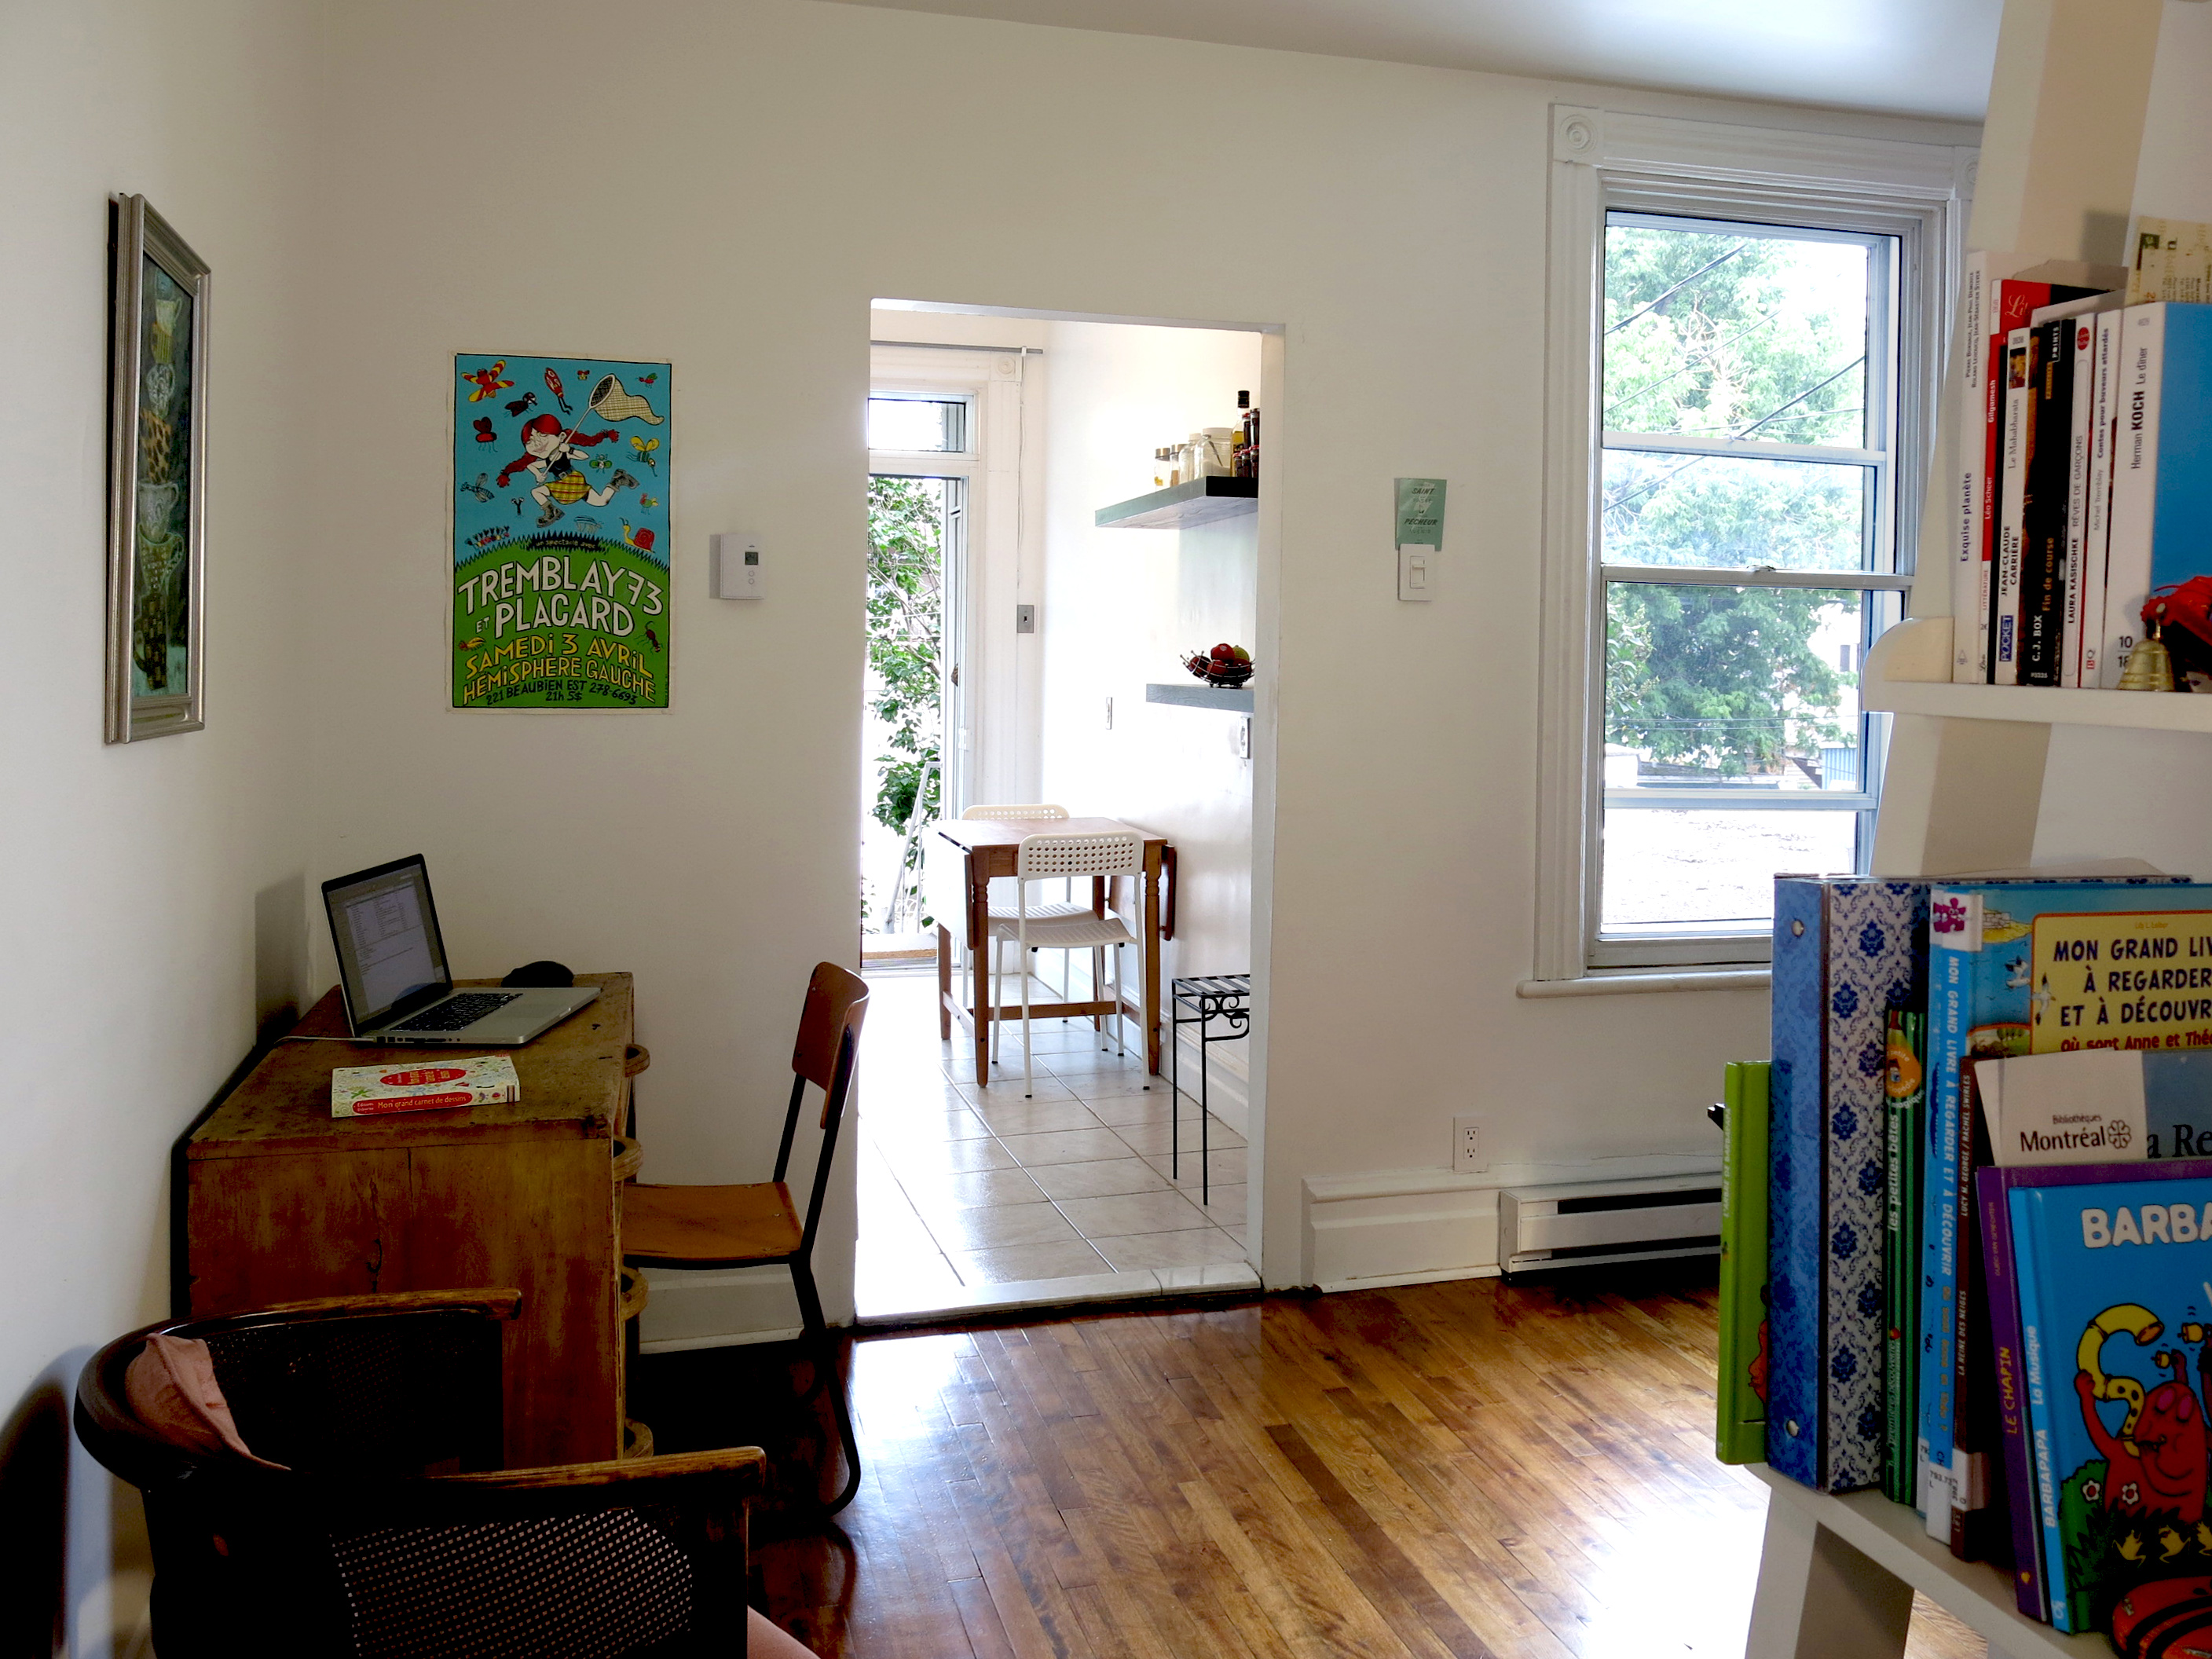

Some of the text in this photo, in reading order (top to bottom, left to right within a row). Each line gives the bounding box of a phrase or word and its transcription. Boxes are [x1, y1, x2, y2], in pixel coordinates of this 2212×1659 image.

[2136, 373, 2146, 385] Le
[2098, 405, 2107, 427] pour
[2131, 390, 2145, 431] KOCH
[2008, 398, 2020, 470] Le Mahabharata
[2074, 435, 2084, 481] GARÇONS
[2130, 433, 2143, 470] Herman
[2073, 483, 2081, 494] DE
[2095, 469, 2104, 504] Tremblay
[1960, 471, 1972, 562] Exquise planète
[2001, 525, 2011, 597] JEAN-CLAUDE
[2042, 537, 2055, 612] Fin de course
[2067, 538, 2078, 624] LAURA KASISCHKE
[475, 593, 635, 639] ET PLACARD
[2033, 614, 2042, 637] BOX
[562, 633, 579, 655] 3
[2000, 615, 2013, 661] POCKET
[2119, 635, 2133, 649] 10
[485, 690, 504, 705] 221
[566, 679, 588, 691] EST
[589, 681, 639, 705] 278-6693
[545, 690, 583, 702] 21h 5$
[585, 659, 657, 704] GAUCHE
[2053, 939, 2099, 962] MON
[2111, 937, 2178, 961] GRAND
[1948, 955, 1959, 985] MON
[2083, 965, 2212, 994] À REGARDER
[1946, 990, 1958, 1034] GRAND
[2060, 995, 2212, 1027] ET À DÉCOUVR
[1946, 1039, 1957, 1074] LIVRE
[2060, 1036, 2080, 1052] Où
[2086, 1037, 2119, 1051] sont
[2124, 1033, 2160, 1050] Anne
[2166, 1033, 2181, 1047] et
[1946, 1080, 1959, 1089] À
[394, 1100, 413, 1109] grand
[2052, 1114, 2102, 1125] Bibliothèques
[1943, 1094, 1956, 1163] REGARDER
[1961, 1111, 1970, 1142] RACHEL
[2020, 1126, 2106, 1152] Montréal
[1723, 1165, 1730, 1177] DE
[1887, 1114, 1902, 1232] les petites bêtes
[1943, 1166, 1954, 1184] ET
[1961, 1150, 1970, 1182] GEORGE
[1943, 1188, 1957, 1198] À
[1961, 1196, 1969, 1218] LUCY
[1941, 1203, 1957, 1276] DÉCOUVRIR
[1958, 1290, 1967, 1319] NEIGES
[1957, 1339, 1966, 1364] REINE
[1958, 1365, 1965, 1376] LA
[1999, 1346, 2018, 1434] LE CHAPIN
[2027, 1325, 2057, 1529] BARBAPAPA La Musique
